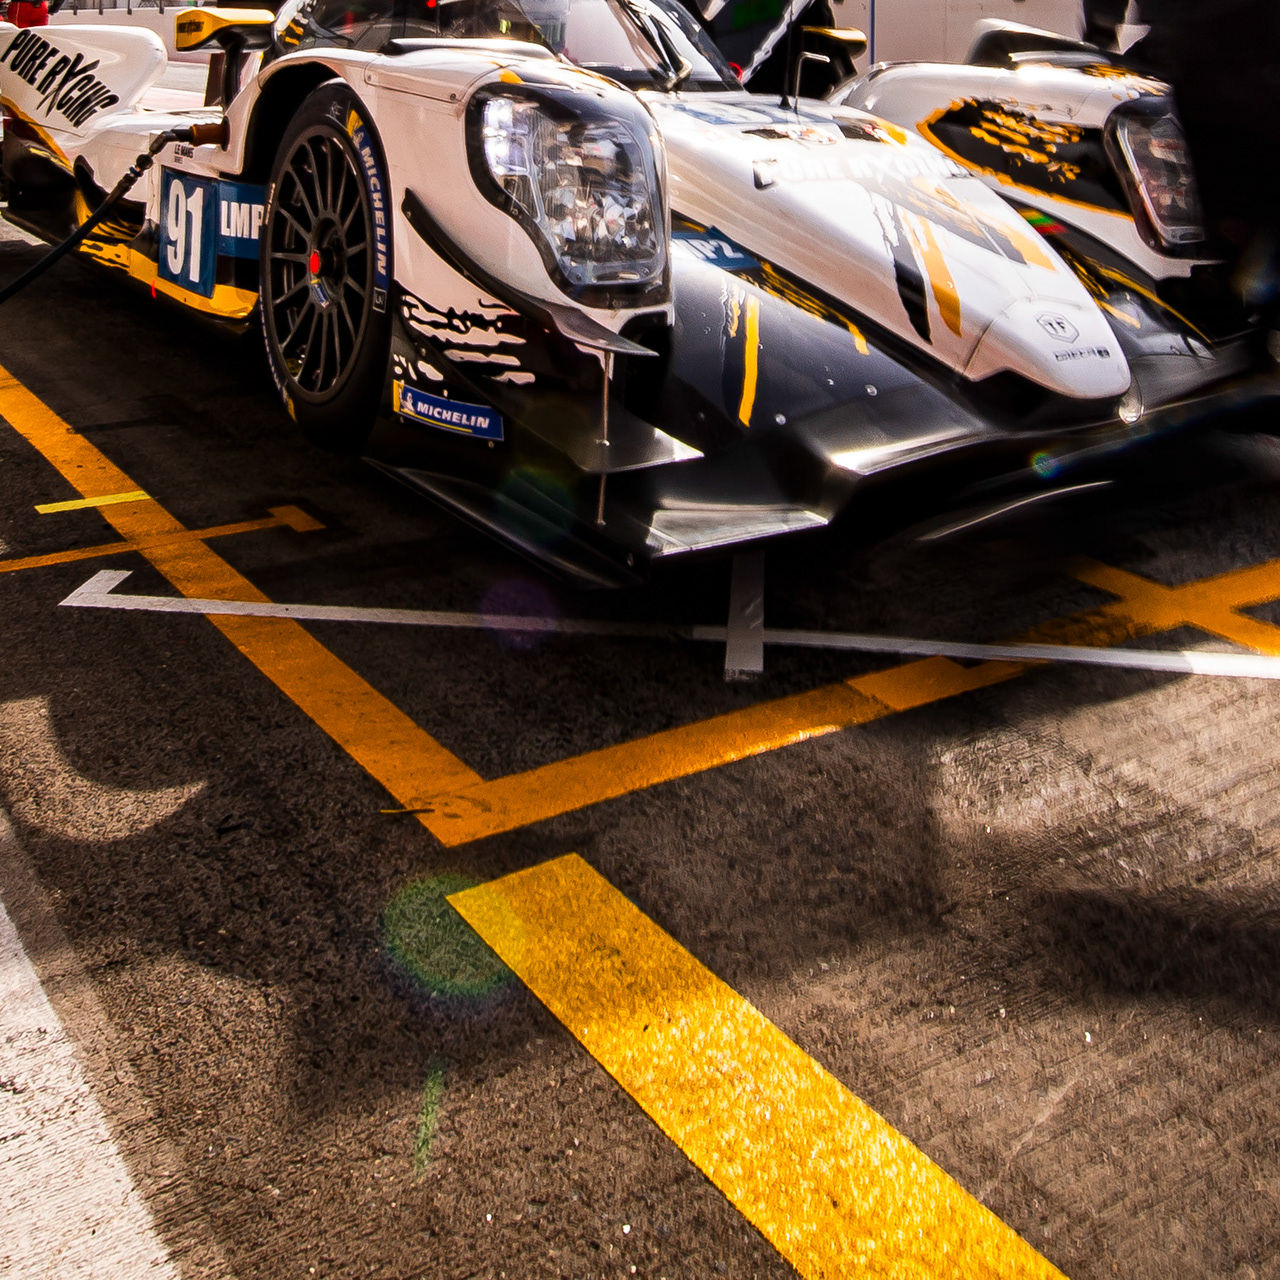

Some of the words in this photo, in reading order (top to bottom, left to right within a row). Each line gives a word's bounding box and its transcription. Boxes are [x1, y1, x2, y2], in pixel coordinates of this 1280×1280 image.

[0, 28, 61, 85] PURE
[167, 178, 204, 284] 91
[360, 146, 387, 276] MICHELIN
[416, 400, 490, 429] MICHELIN
